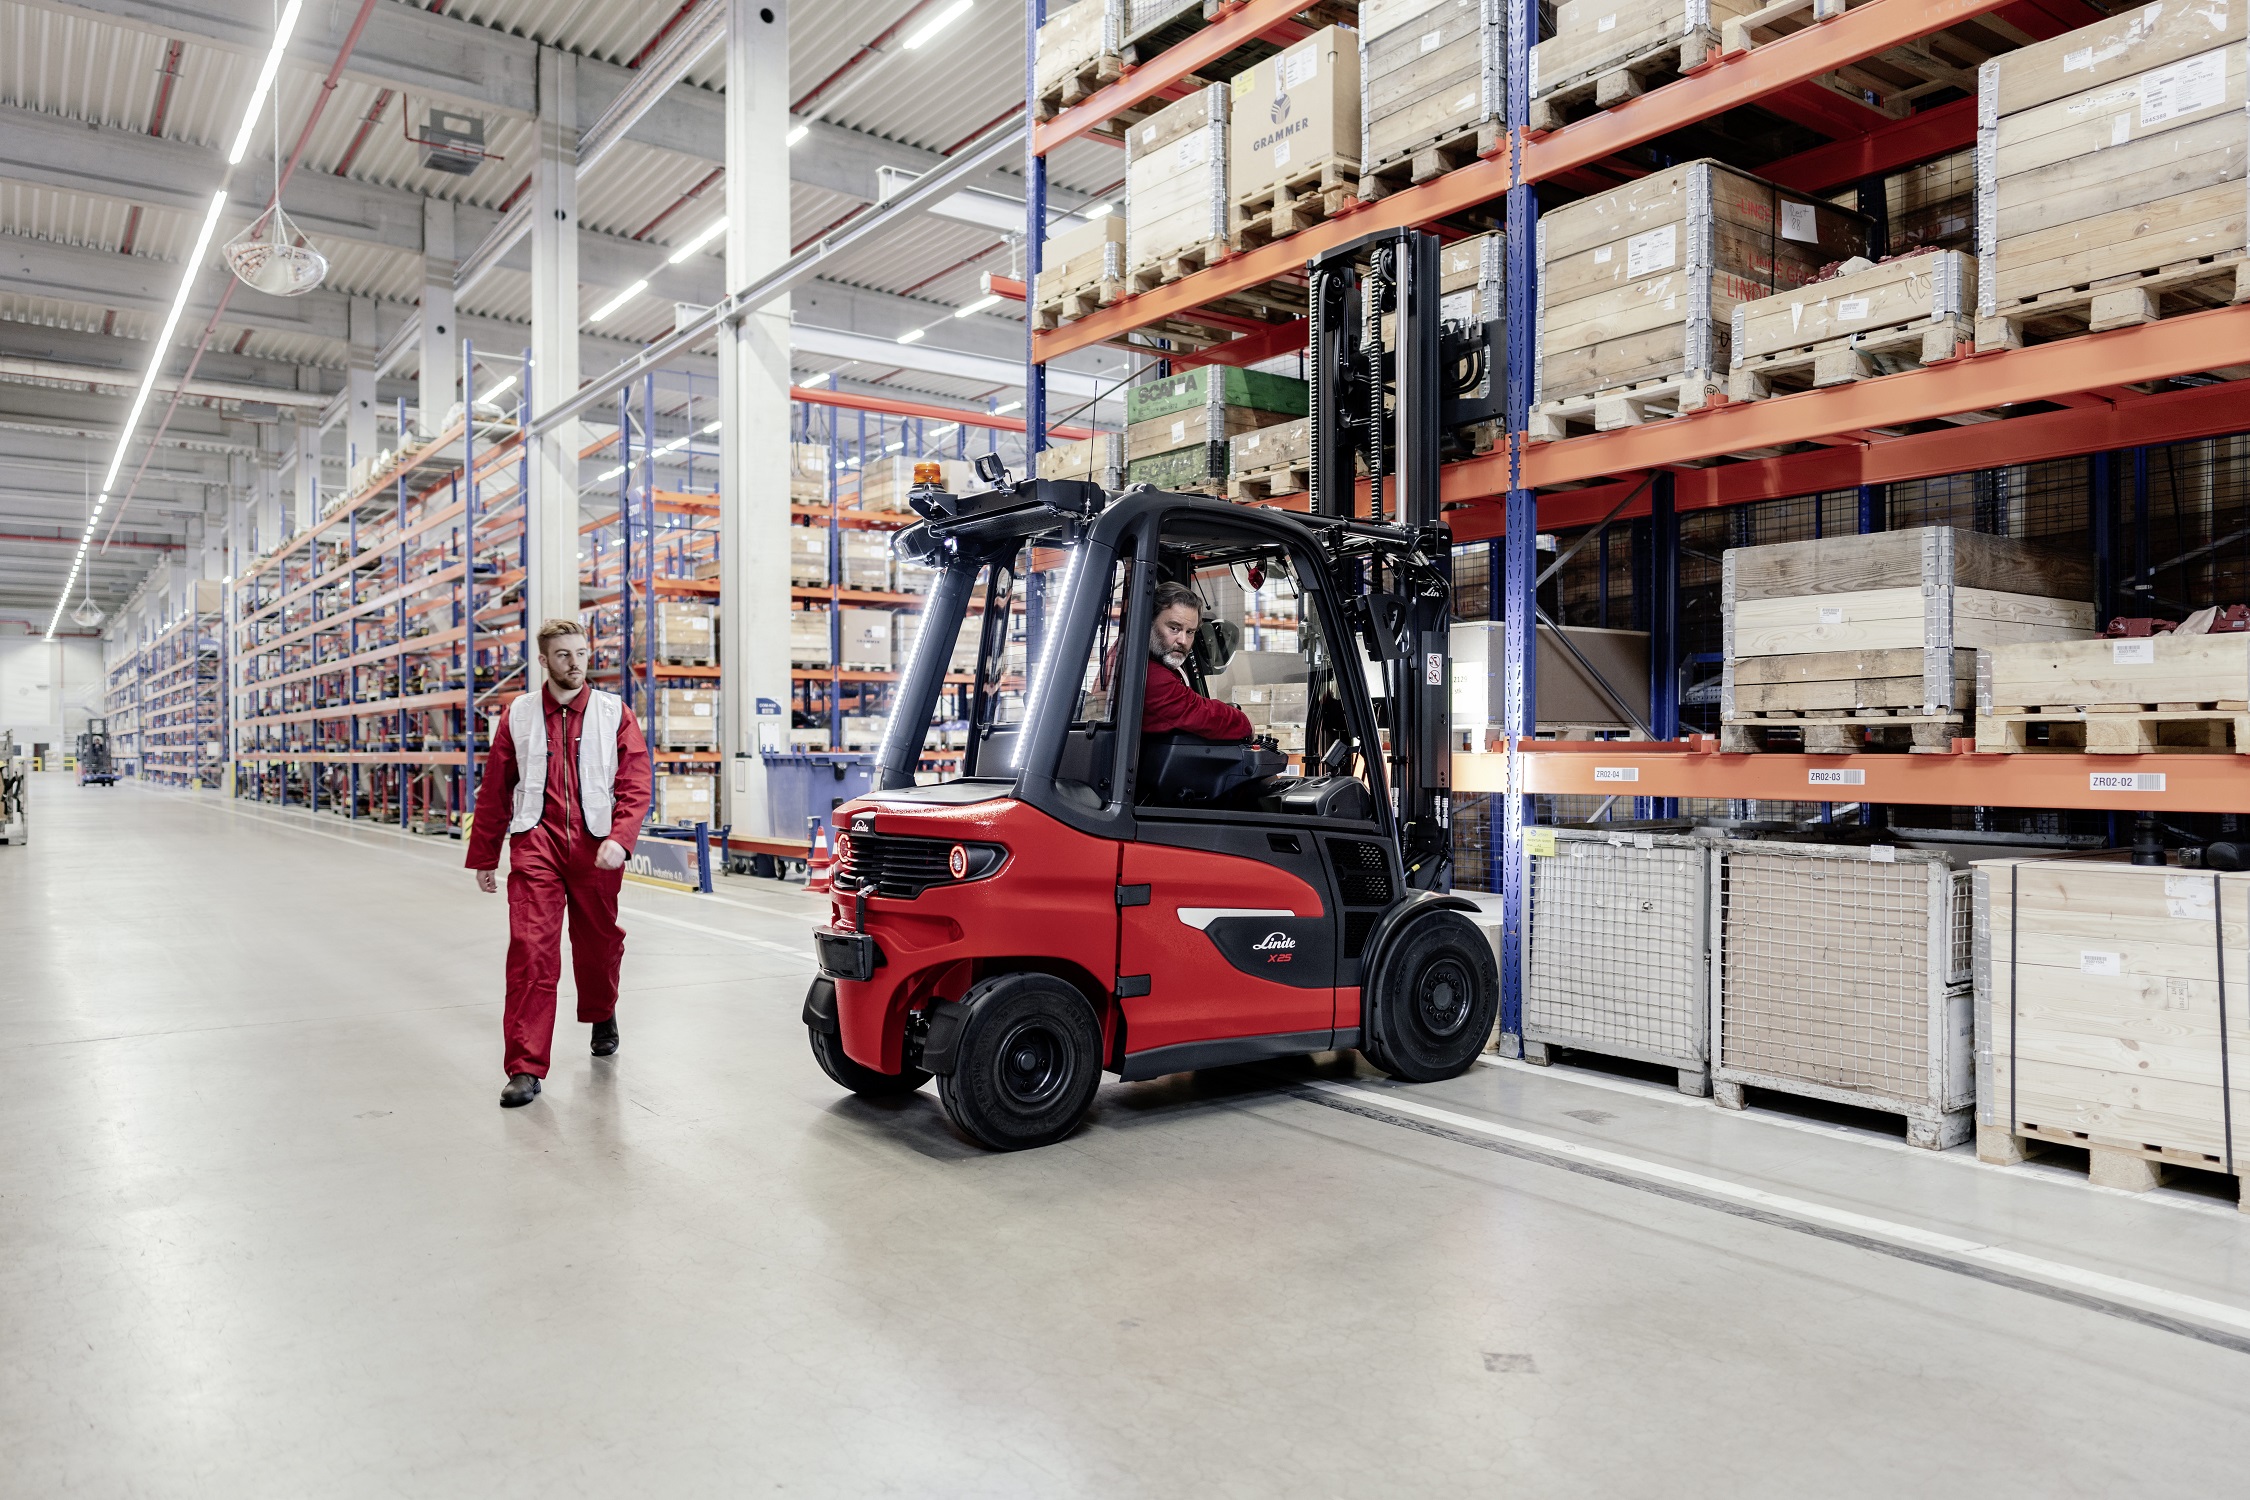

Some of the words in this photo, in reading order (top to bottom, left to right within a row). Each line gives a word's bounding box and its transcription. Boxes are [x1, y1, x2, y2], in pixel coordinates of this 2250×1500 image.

[1253, 117, 1309, 152] GRAMMER
[1726, 274, 1771, 302] LINDE
[1420, 586, 1440, 597] Lin
[1596, 770, 1620, 778] ZR02-04
[1810, 773, 1841, 781] ZR02-03
[2093, 777, 2133, 787] ZR02-02
[851, 819, 869, 833] Linde
[1252, 931, 1296, 950] Linde
